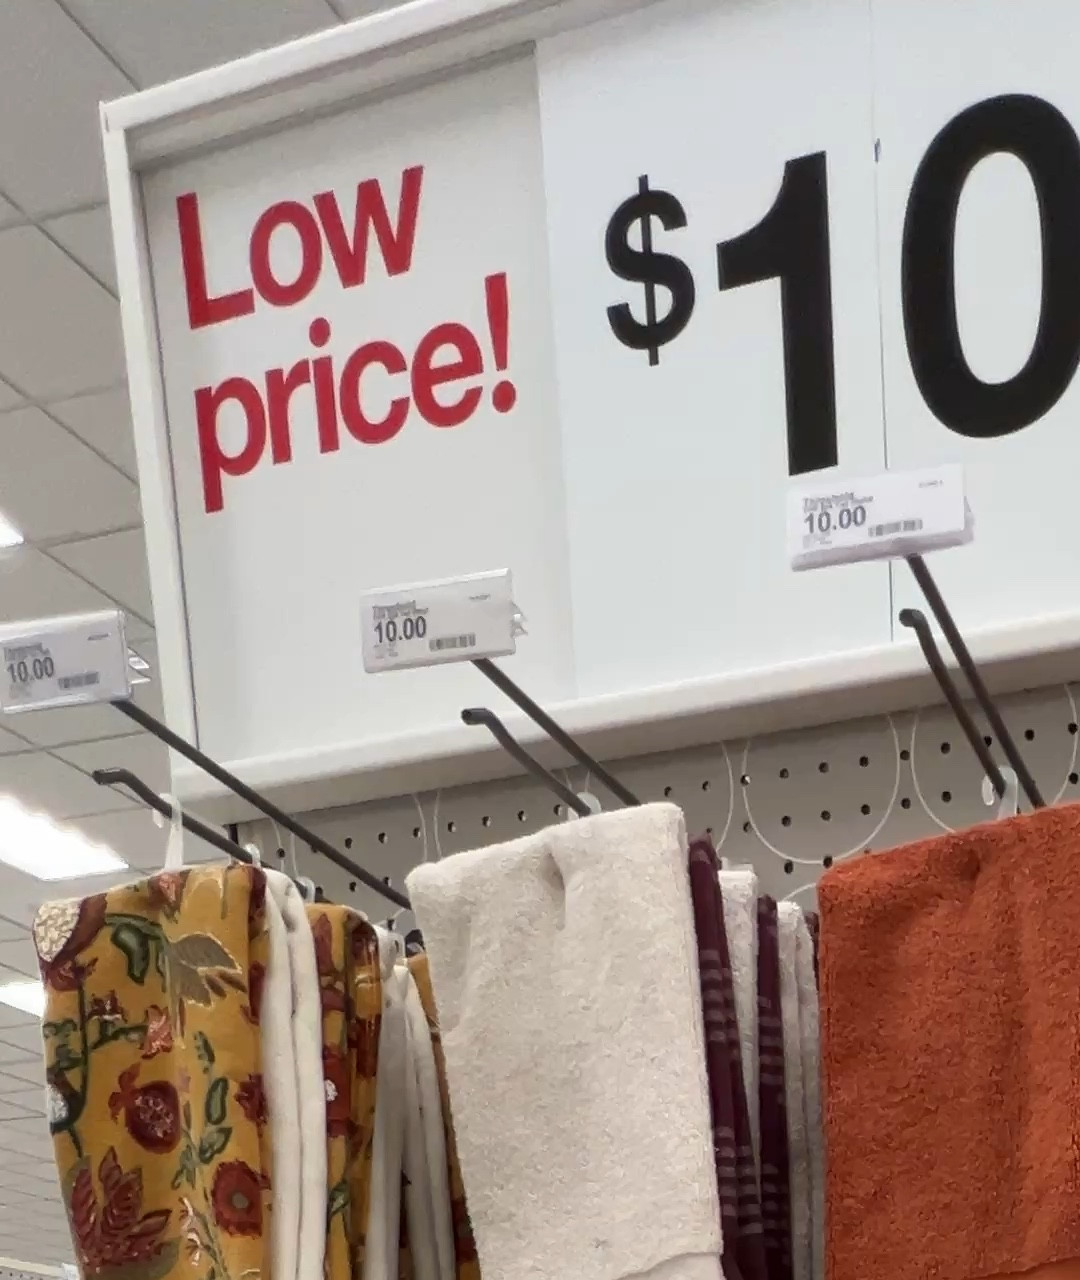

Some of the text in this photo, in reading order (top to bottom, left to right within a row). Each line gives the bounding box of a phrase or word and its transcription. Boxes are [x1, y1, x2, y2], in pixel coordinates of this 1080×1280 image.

[176, 166, 424, 329] Low
[193, 272, 517, 513] price!
[804, 505, 866, 534] 10.00
[374, 616, 427, 643] 10.00
[7, 656, 54, 682] 10.00
